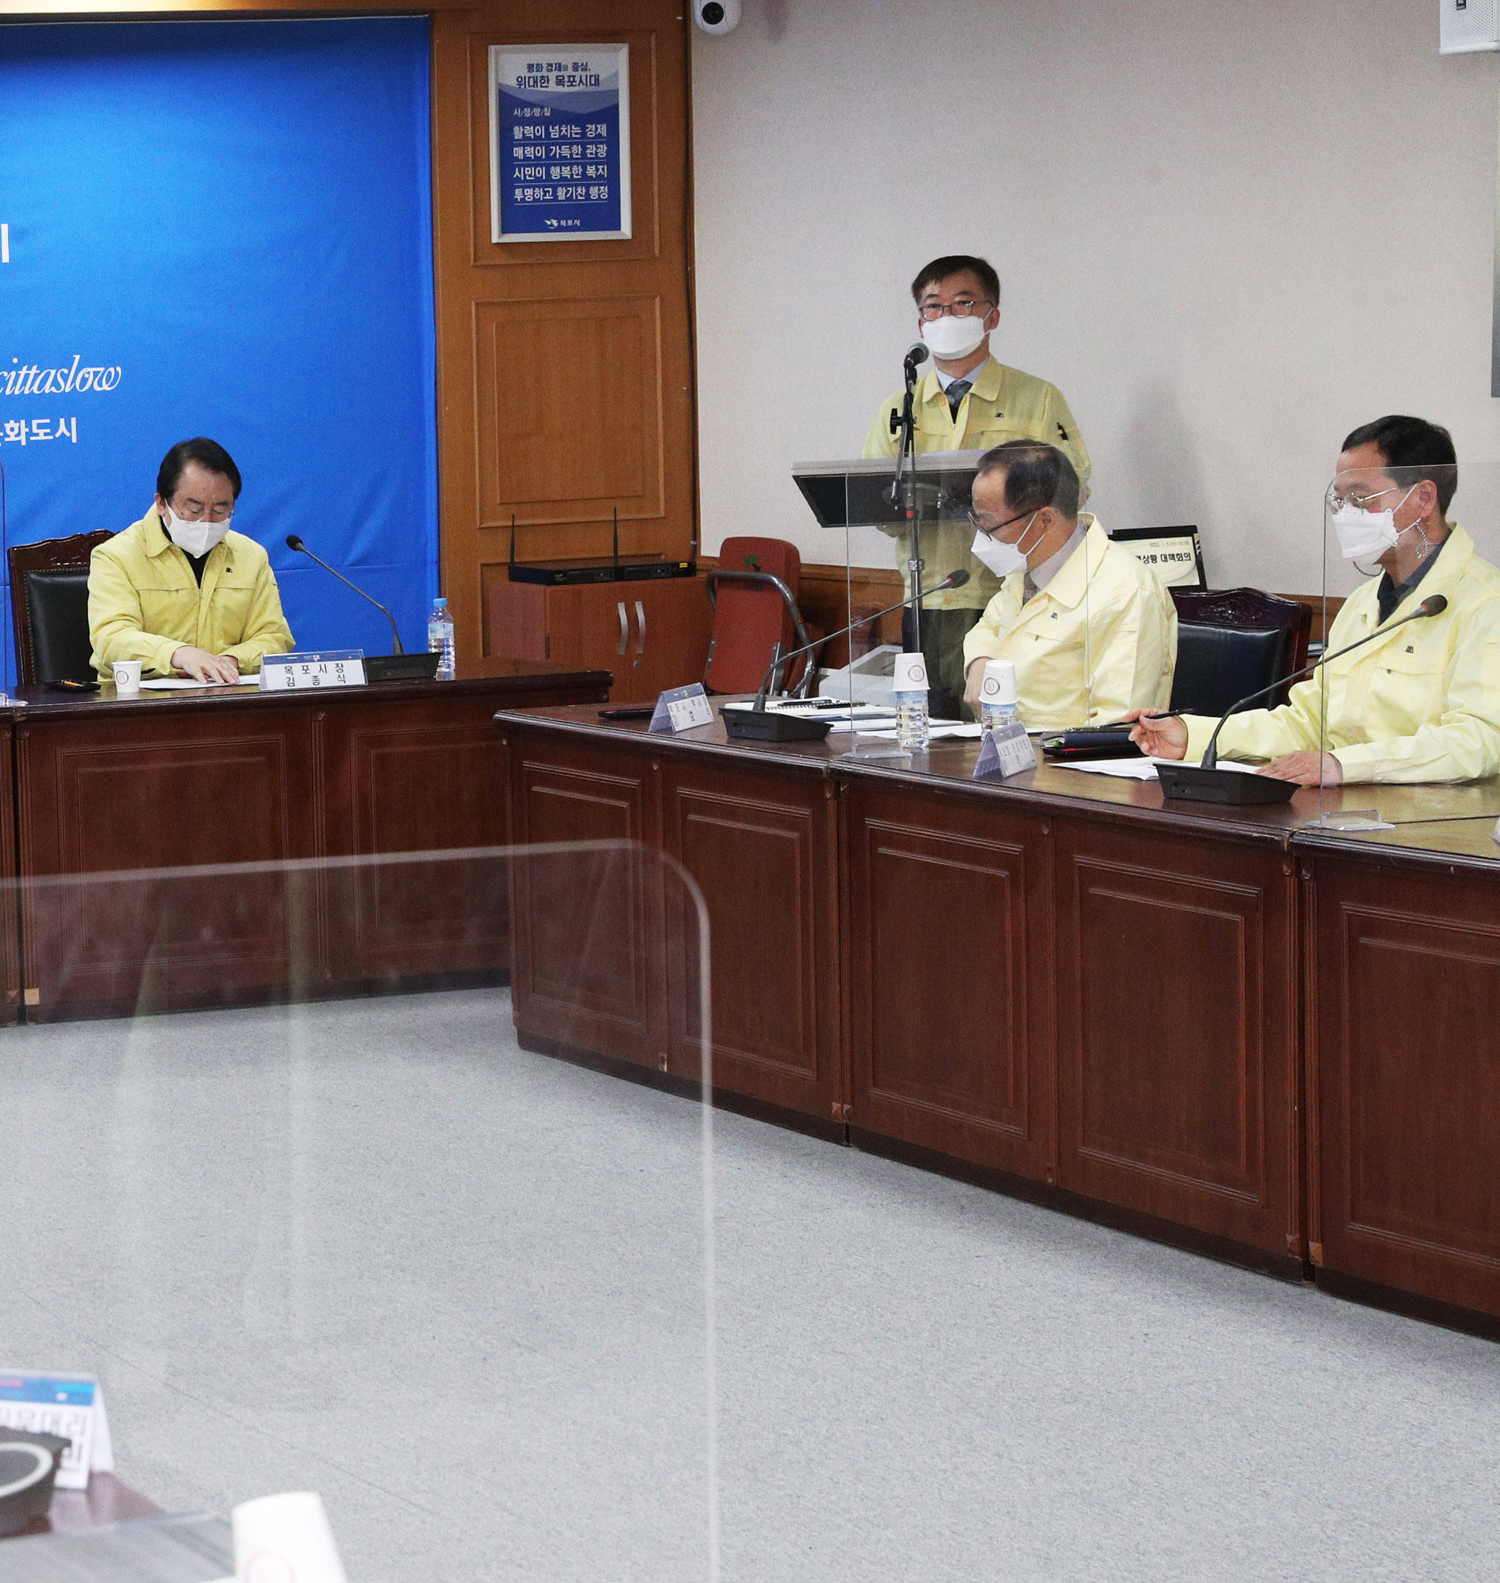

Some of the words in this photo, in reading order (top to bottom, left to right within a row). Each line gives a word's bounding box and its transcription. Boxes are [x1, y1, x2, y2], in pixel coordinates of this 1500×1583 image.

[527, 62, 544, 73] 평화
[516, 75, 550, 89] 위대한
[555, 74, 600, 88] 목포시대
[513, 125, 545, 140] 활력이
[549, 124, 582, 139] 넘치는
[585, 123, 607, 137] 경제
[513, 146, 545, 160] 매력이
[550, 145, 582, 159] 가득한
[585, 144, 607, 158] 관광
[513, 166, 546, 180] 시민이
[550, 165, 582, 179] 행복한
[586, 164, 608, 178] 복지
[514, 187, 553, 202] 투명하고
[557, 186, 586, 200] 활기찬
[589, 185, 608, 199] 행정
[1160, 552, 1192, 563] 대책회의
